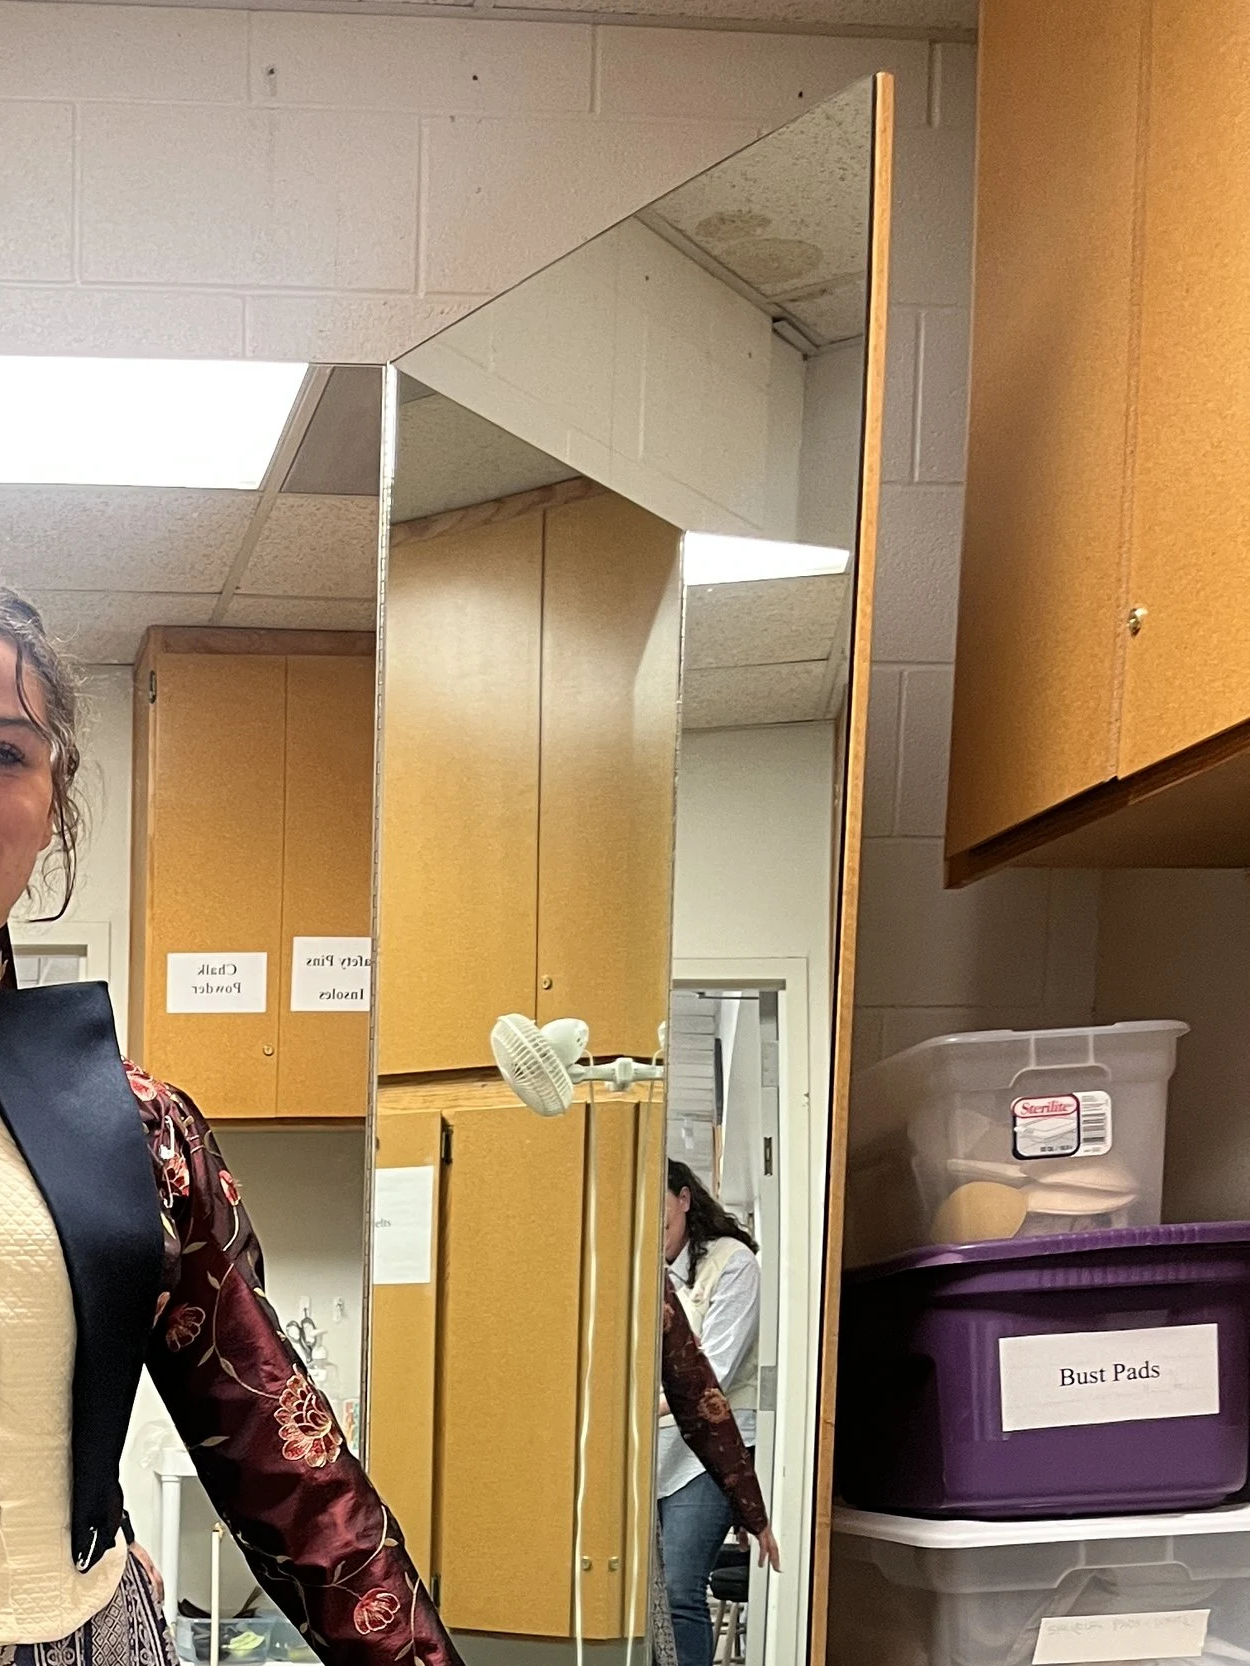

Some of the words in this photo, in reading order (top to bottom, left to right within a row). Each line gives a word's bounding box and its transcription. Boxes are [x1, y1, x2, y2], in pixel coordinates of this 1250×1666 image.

[1021, 1100, 1067, 1115] Sterilite
[375, 1217, 392, 1228] elts
[1059, 1367, 1106, 1387] Bust
[1112, 1359, 1161, 1382] Pads
